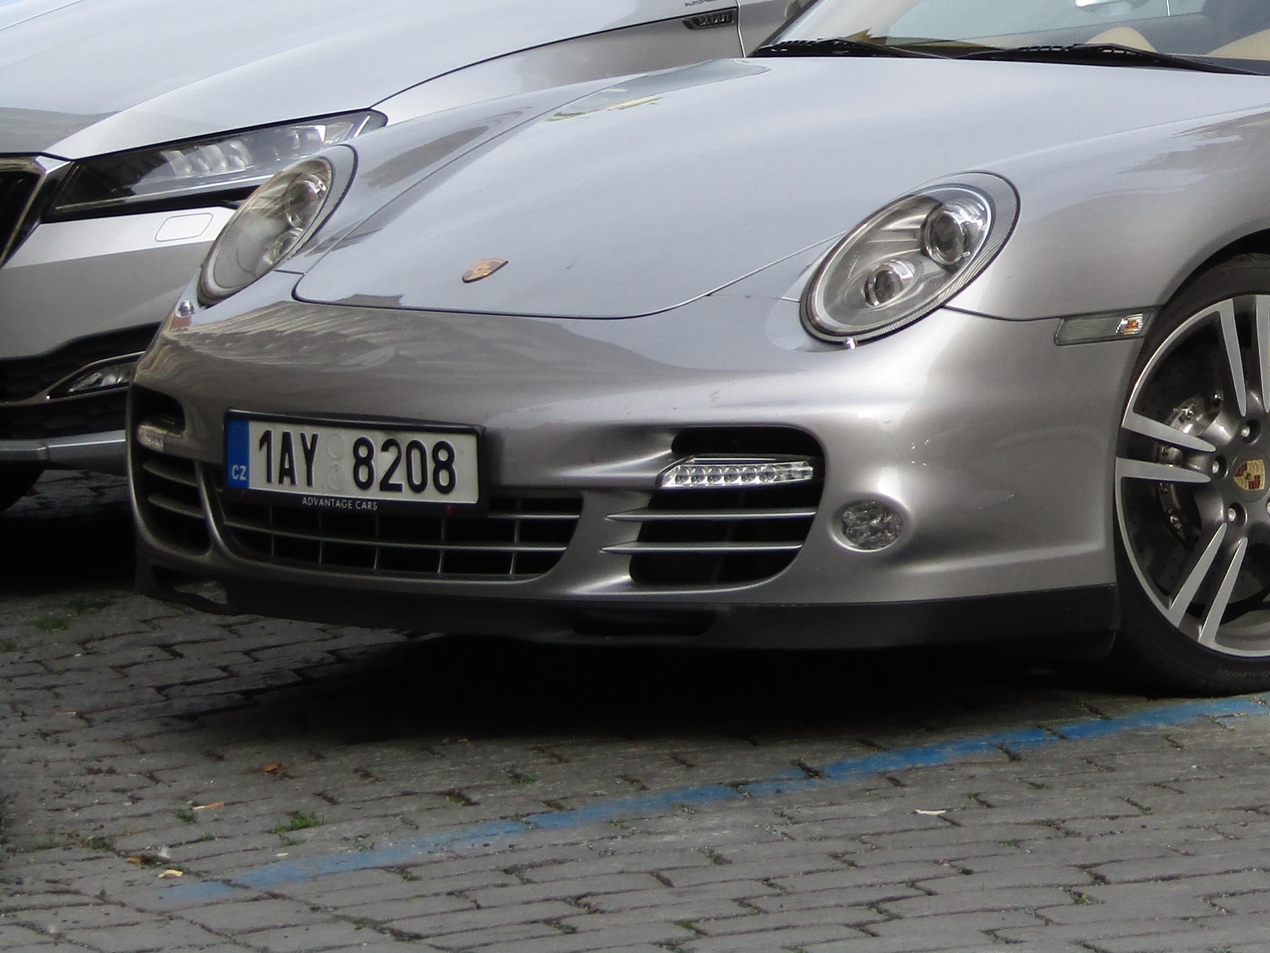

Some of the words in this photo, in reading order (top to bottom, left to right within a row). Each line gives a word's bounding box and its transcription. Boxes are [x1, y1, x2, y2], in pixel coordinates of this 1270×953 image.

[259, 430, 318, 487] 1AY
[353, 437, 457, 494] 8208
[232, 465, 247, 481] CZ
[302, 497, 353, 509] ADVANTAGE
[355, 501, 378, 511] CARS
